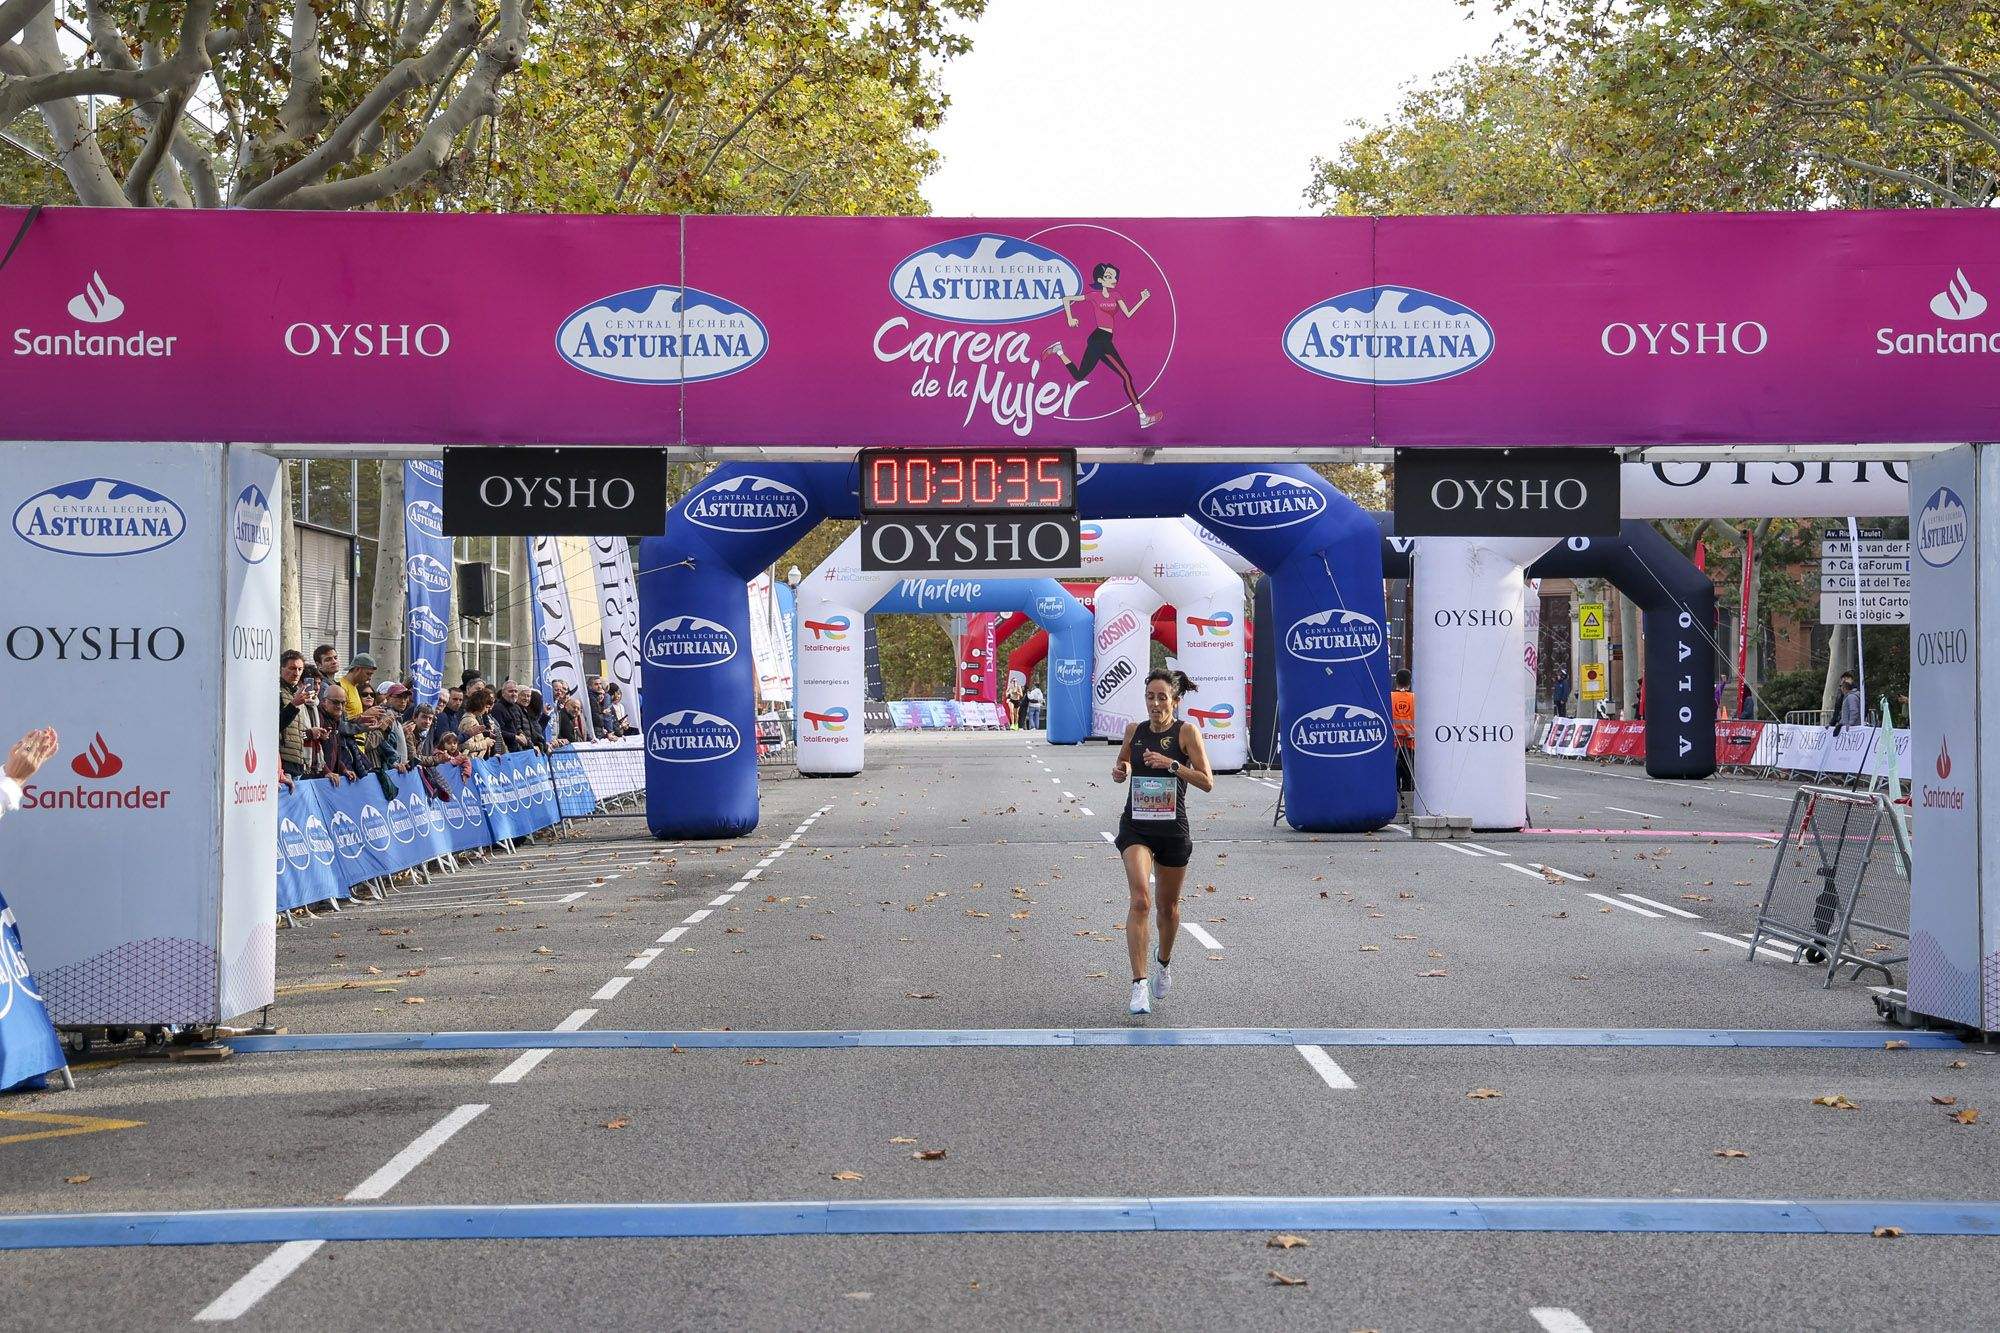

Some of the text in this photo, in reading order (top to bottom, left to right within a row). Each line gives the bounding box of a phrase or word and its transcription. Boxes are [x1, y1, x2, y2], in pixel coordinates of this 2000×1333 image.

[935, 264, 1062, 273] CENTRAL LECHERA
[905, 266, 1067, 300] ASTURIANA
[605, 319, 745, 329] CENTRAL LECHERA
[1332, 320, 1471, 329] CENTRAL LECHERA
[13, 328, 177, 358] Santander
[284, 322, 450, 357] OYSHO
[573, 321, 752, 358] ASTURIANA
[873, 316, 1031, 364] Carrera
[1299, 321, 1478, 358] ASTURIANA
[1601, 321, 1768, 356] OYSHO
[911, 359, 1089, 437] de la Mujer
[411, 460, 443, 480] ASTURIA
[873, 458, 1062, 504] 00:30:35
[479, 475, 635, 510] OYSHO
[1225, 492, 1267, 501] CENTRAL
[1431, 478, 1588, 511] OYSHO
[53, 504, 168, 514] CENTRAL LECHERA
[691, 498, 798, 518] ASTURIANA
[1210, 496, 1319, 517] ASTURIANA
[26, 506, 173, 537] ASTURIANA
[411, 508, 443, 531] ASTURIA
[871, 521, 1070, 564] OYSHO
[1919, 520, 1964, 551] ASTURIANA
[1840, 543, 1863, 552] Mis
[1886, 543, 1903, 552] der
[1839, 560, 1902, 570] CaxaForum
[1839, 577, 1910, 587] Ciuat del Tea
[901, 579, 982, 608] Marlene
[1838, 597, 1909, 606] Insttut Carto
[1434, 609, 1513, 628] OYSHO
[1838, 610, 1842, 619] i
[1098, 613, 1136, 650] COSMO
[1305, 625, 1375, 634] CENTRAL LECHERA
[6, 625, 186, 661] OYSHO
[232, 624, 273, 662] OYSHO
[647, 638, 732, 658] ASTURIANA
[804, 644, 850, 653] TotalEnergies
[1186, 640, 1234, 649] TotalEnergies
[1291, 630, 1378, 651] ASTURIANA
[1917, 628, 1967, 667] OYSHO
[1096, 660, 1132, 700] COSMO
[1188, 675, 1234, 683] otalenergies.es
[1678, 611, 1692, 758] VOLVO
[1295, 725, 1383, 745] ASTURIANA
[1309, 721, 1344, 729] CENTRAL
[1434, 724, 1514, 743] OYSHO
[651, 731, 735, 751] ASTURIANA
[803, 735, 849, 744] TotalEnergies
[1202, 732, 1236, 741] lEnergies
[22, 784, 171, 809] Santander
[234, 780, 268, 805] Santander
[1922, 783, 1964, 811] Santander
